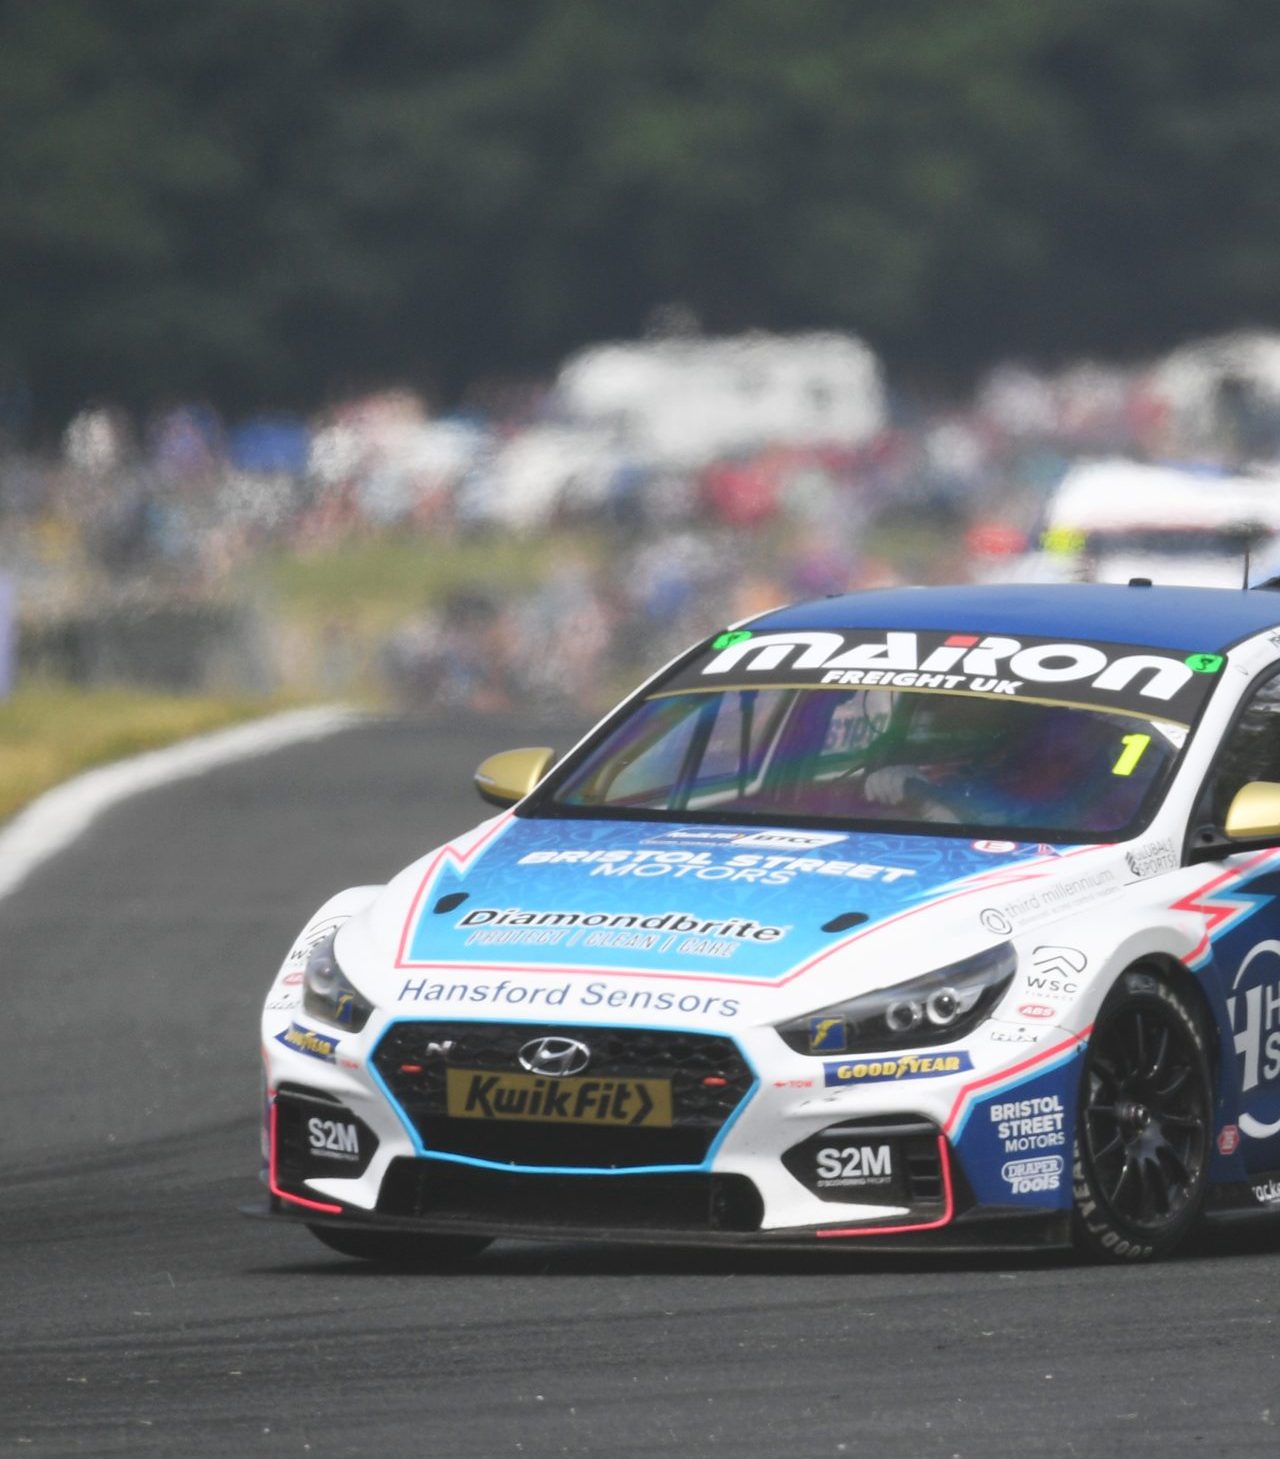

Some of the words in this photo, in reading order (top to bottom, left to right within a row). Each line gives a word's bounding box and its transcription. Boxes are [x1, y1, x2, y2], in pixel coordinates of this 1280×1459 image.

[820, 669, 967, 690] FREIGHT
[968, 677, 1026, 695] UK
[1111, 733, 1152, 777] 1
[517, 850, 713, 866] BRISTOL
[725, 854, 918, 884] STREET
[589, 862, 799, 886] MOTORS
[459, 909, 783, 942] Diamondbrite
[398, 978, 571, 1006] Hansford
[580, 982, 741, 1018] Sensors
[1027, 975, 1078, 994] WSC
[837, 1054, 961, 1080] GOODYEAR
[990, 1095, 1065, 1122] BRISTOL
[307, 1117, 360, 1153] S2M
[997, 1112, 1065, 1139] STREET
[1005, 1131, 1066, 1153] MOTORS
[816, 1144, 892, 1179] S2M
[1008, 1160, 1060, 1178] DRAPER
